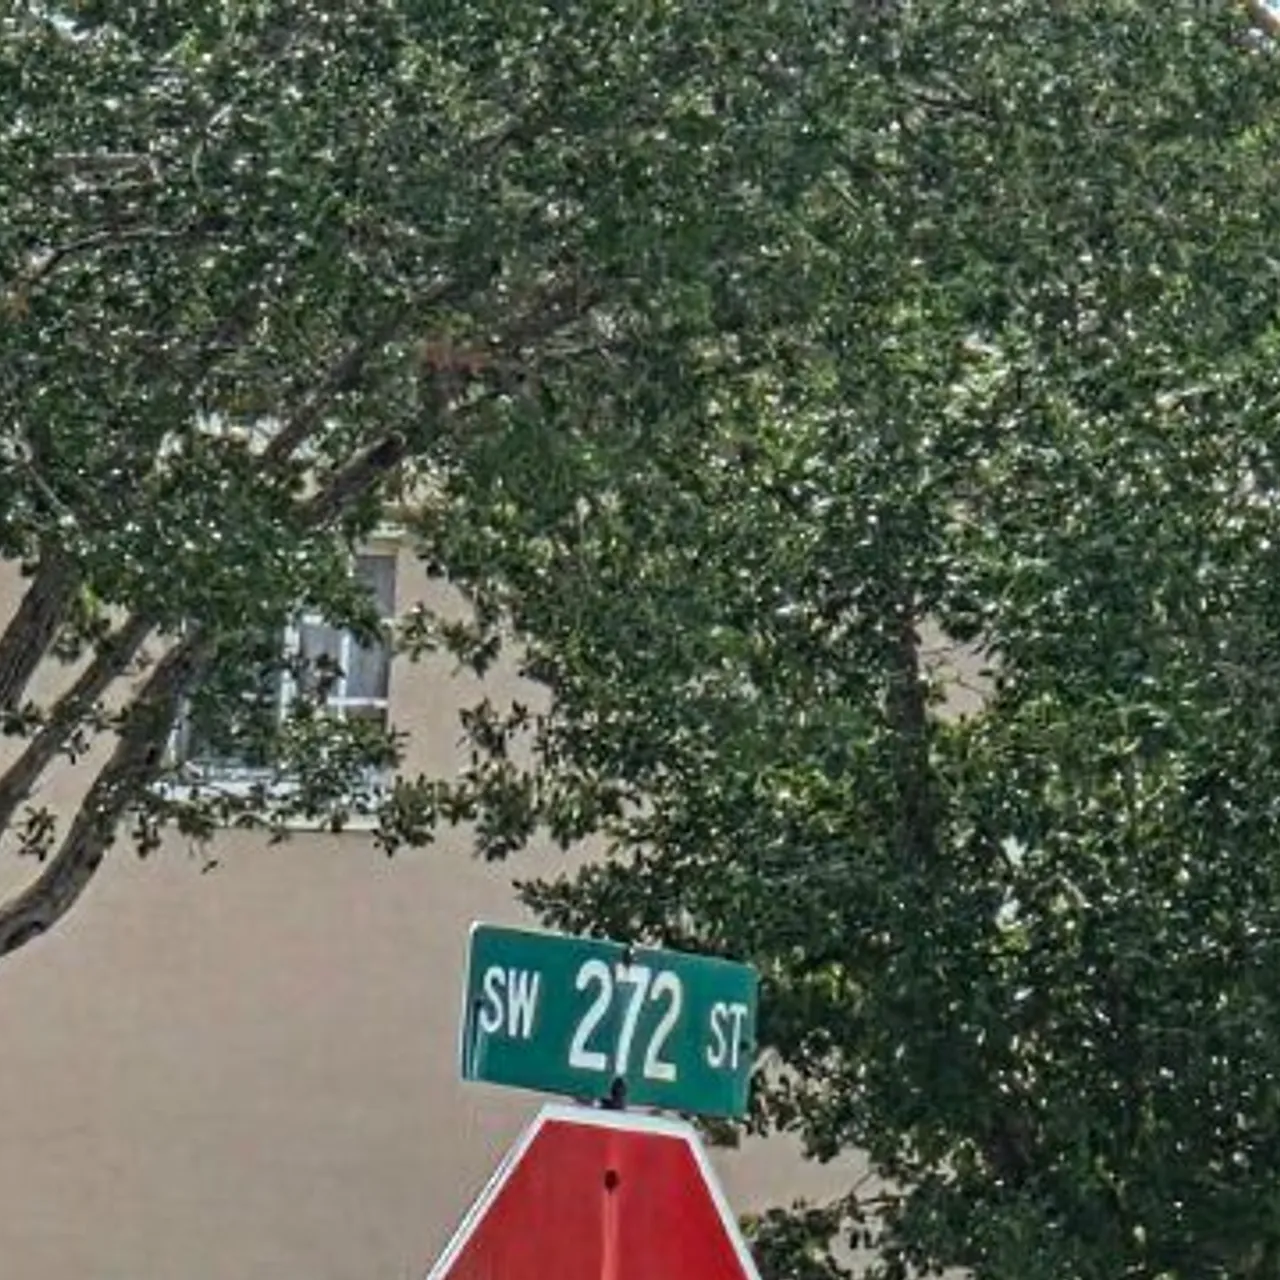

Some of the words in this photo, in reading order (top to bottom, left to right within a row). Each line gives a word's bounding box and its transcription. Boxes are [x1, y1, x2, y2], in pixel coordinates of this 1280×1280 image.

[478, 965, 541, 1040] SW
[568, 958, 683, 1082] 272
[706, 1002, 748, 1070] ST
